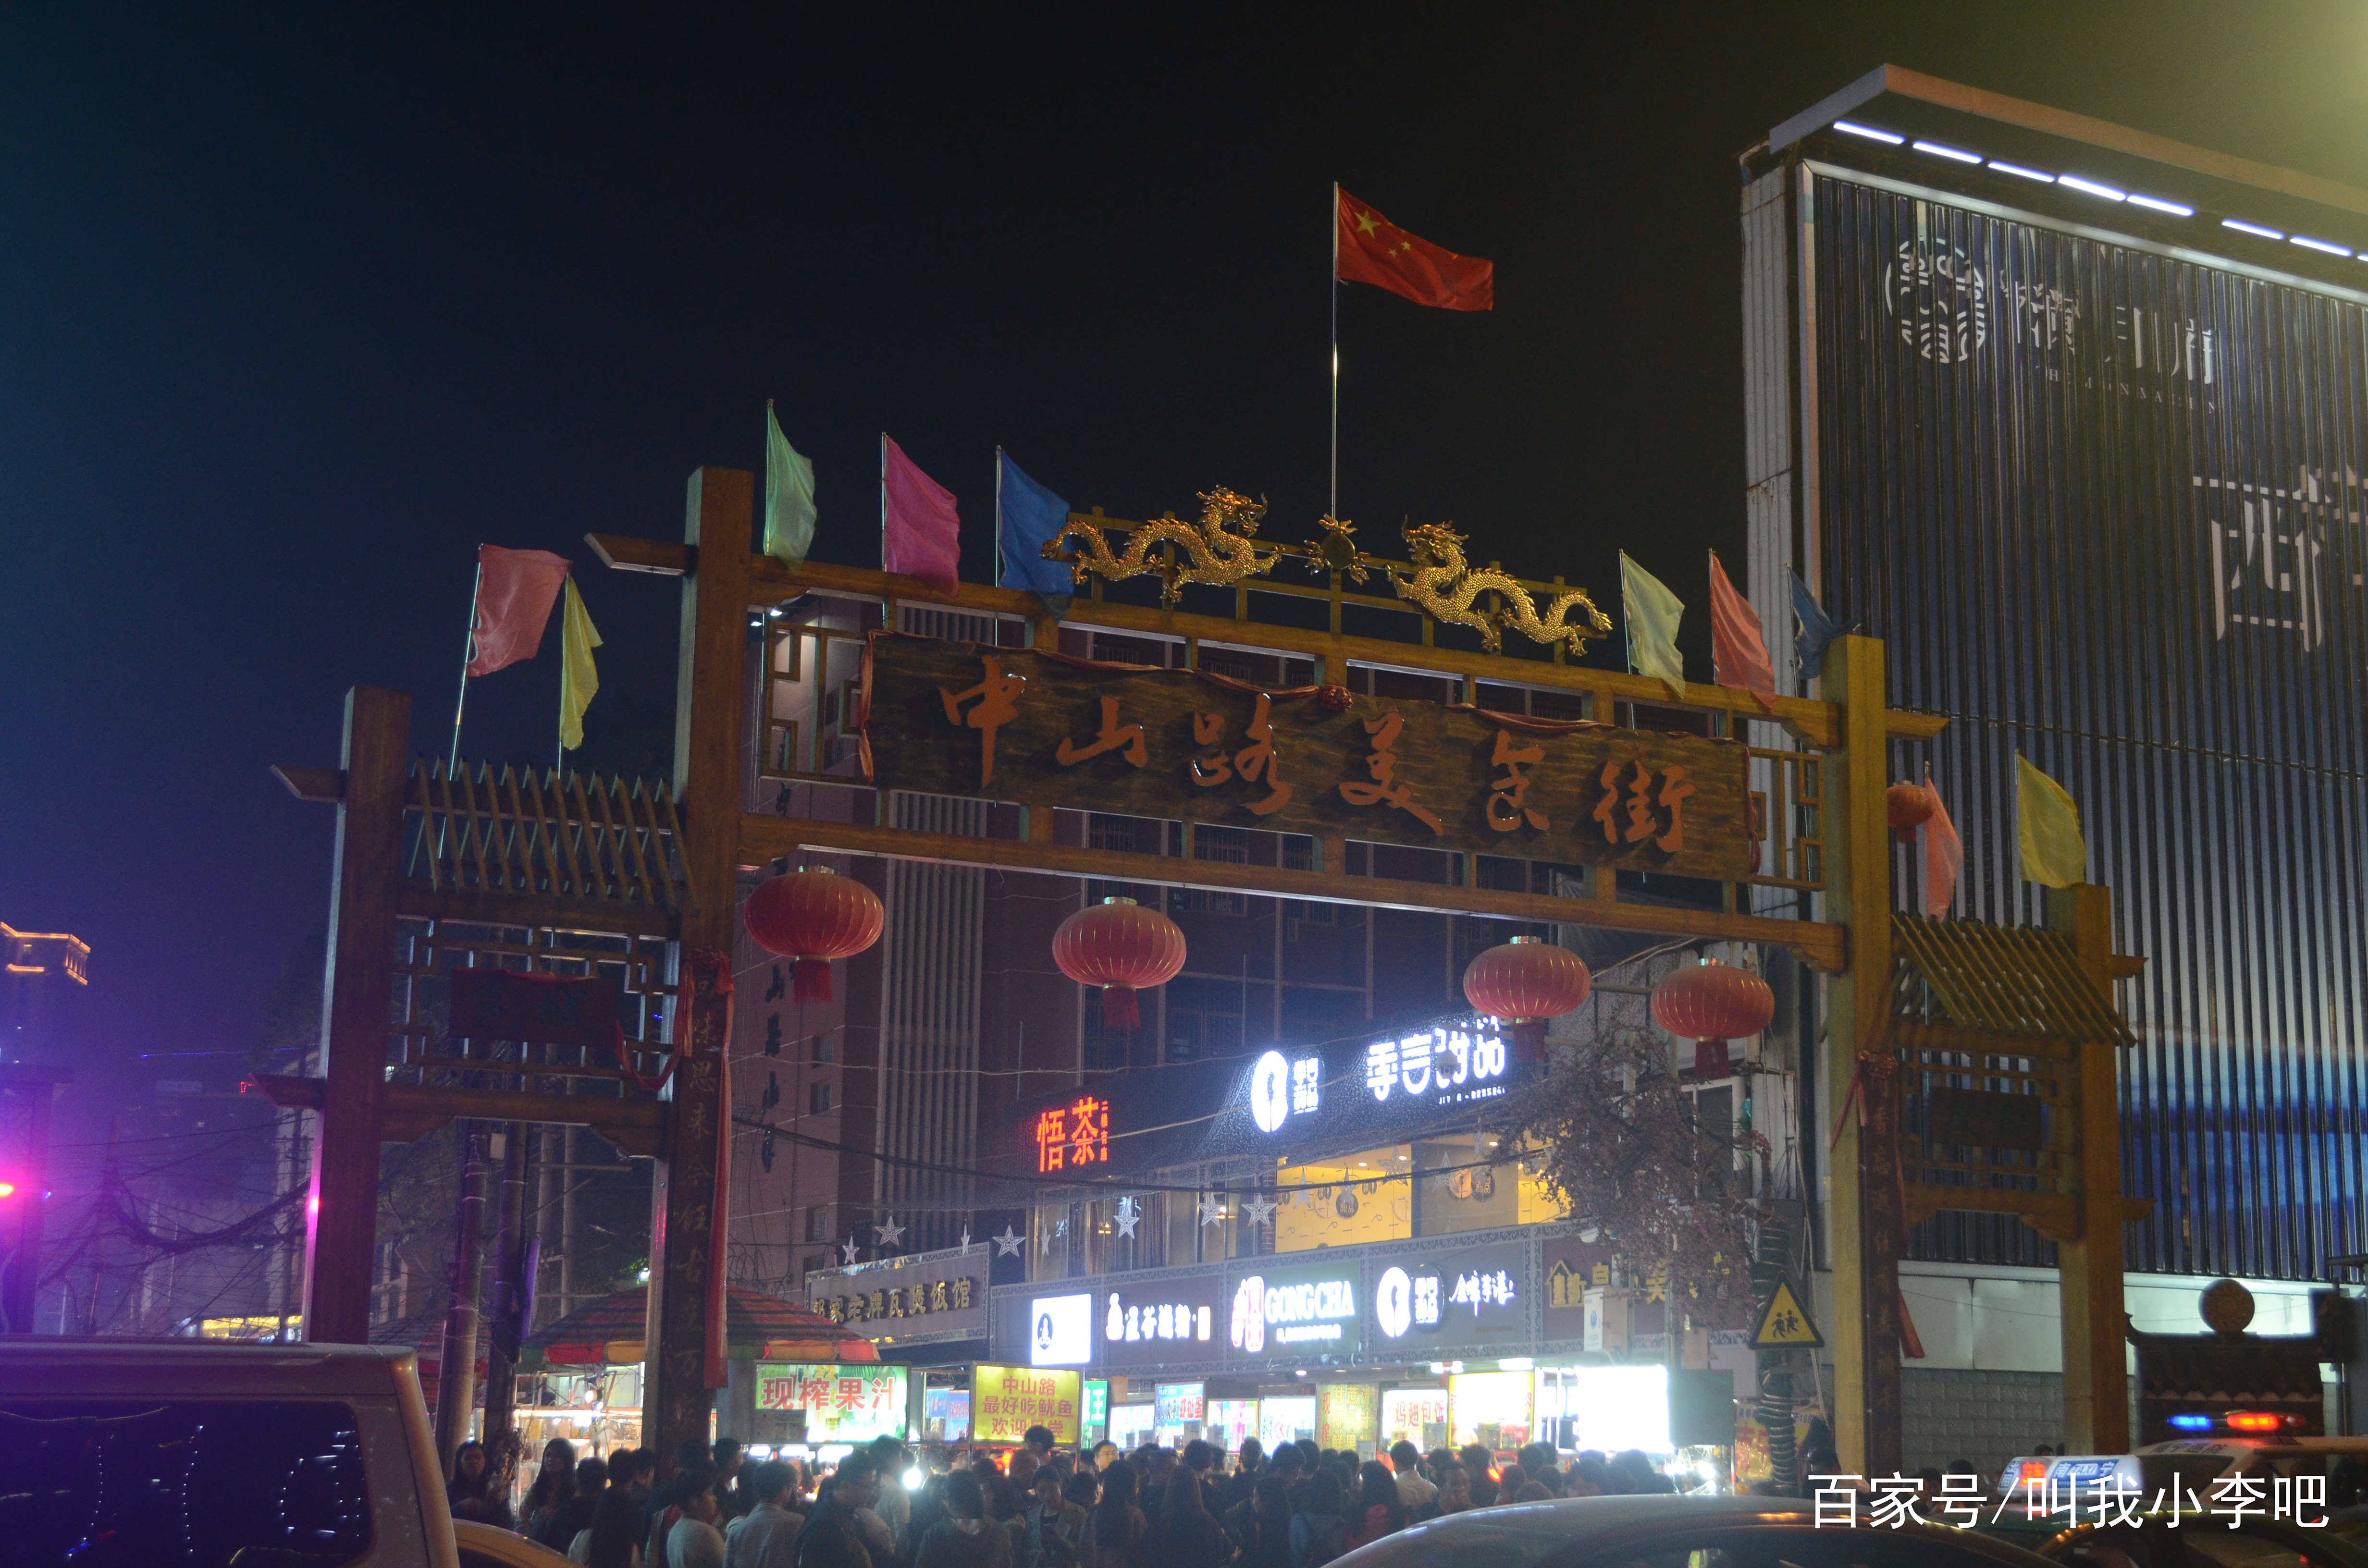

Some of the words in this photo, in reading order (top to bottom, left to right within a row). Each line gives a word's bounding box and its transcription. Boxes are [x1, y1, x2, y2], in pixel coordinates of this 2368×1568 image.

[940, 655, 1696, 853] 中山路美食街
[1036, 1096, 1099, 1173] 悟茶
[762, 1377, 896, 1411] 现榨果汁
[1002, 1375, 1056, 1396] 中山路
[1333, 1385, 1373, 1406] 甘蔗汁
[983, 1396, 1073, 1418] 最好吃鱿鱼
[1332, 1409, 1372, 1430] 椰子汁
